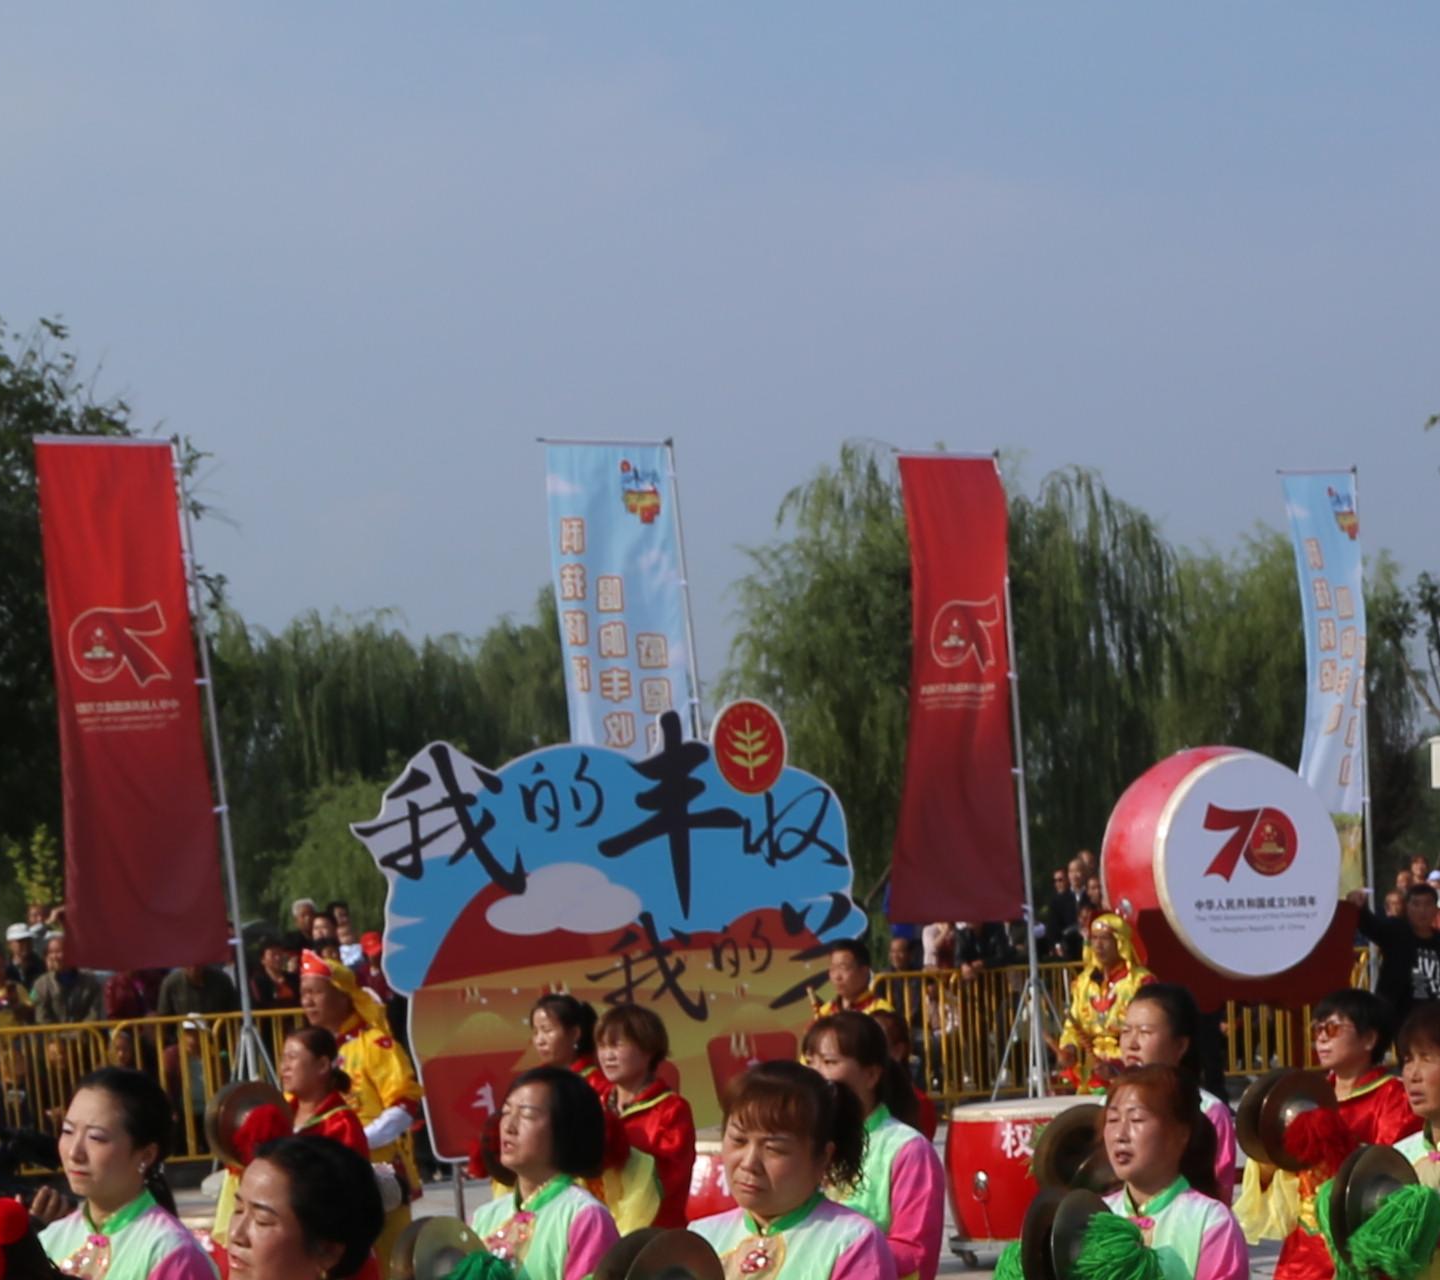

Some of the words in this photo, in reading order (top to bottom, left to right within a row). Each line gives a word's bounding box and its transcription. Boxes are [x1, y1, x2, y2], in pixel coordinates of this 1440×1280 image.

[357, 711, 848, 920] 我的丰收
[1202, 802, 1298, 883] 70
